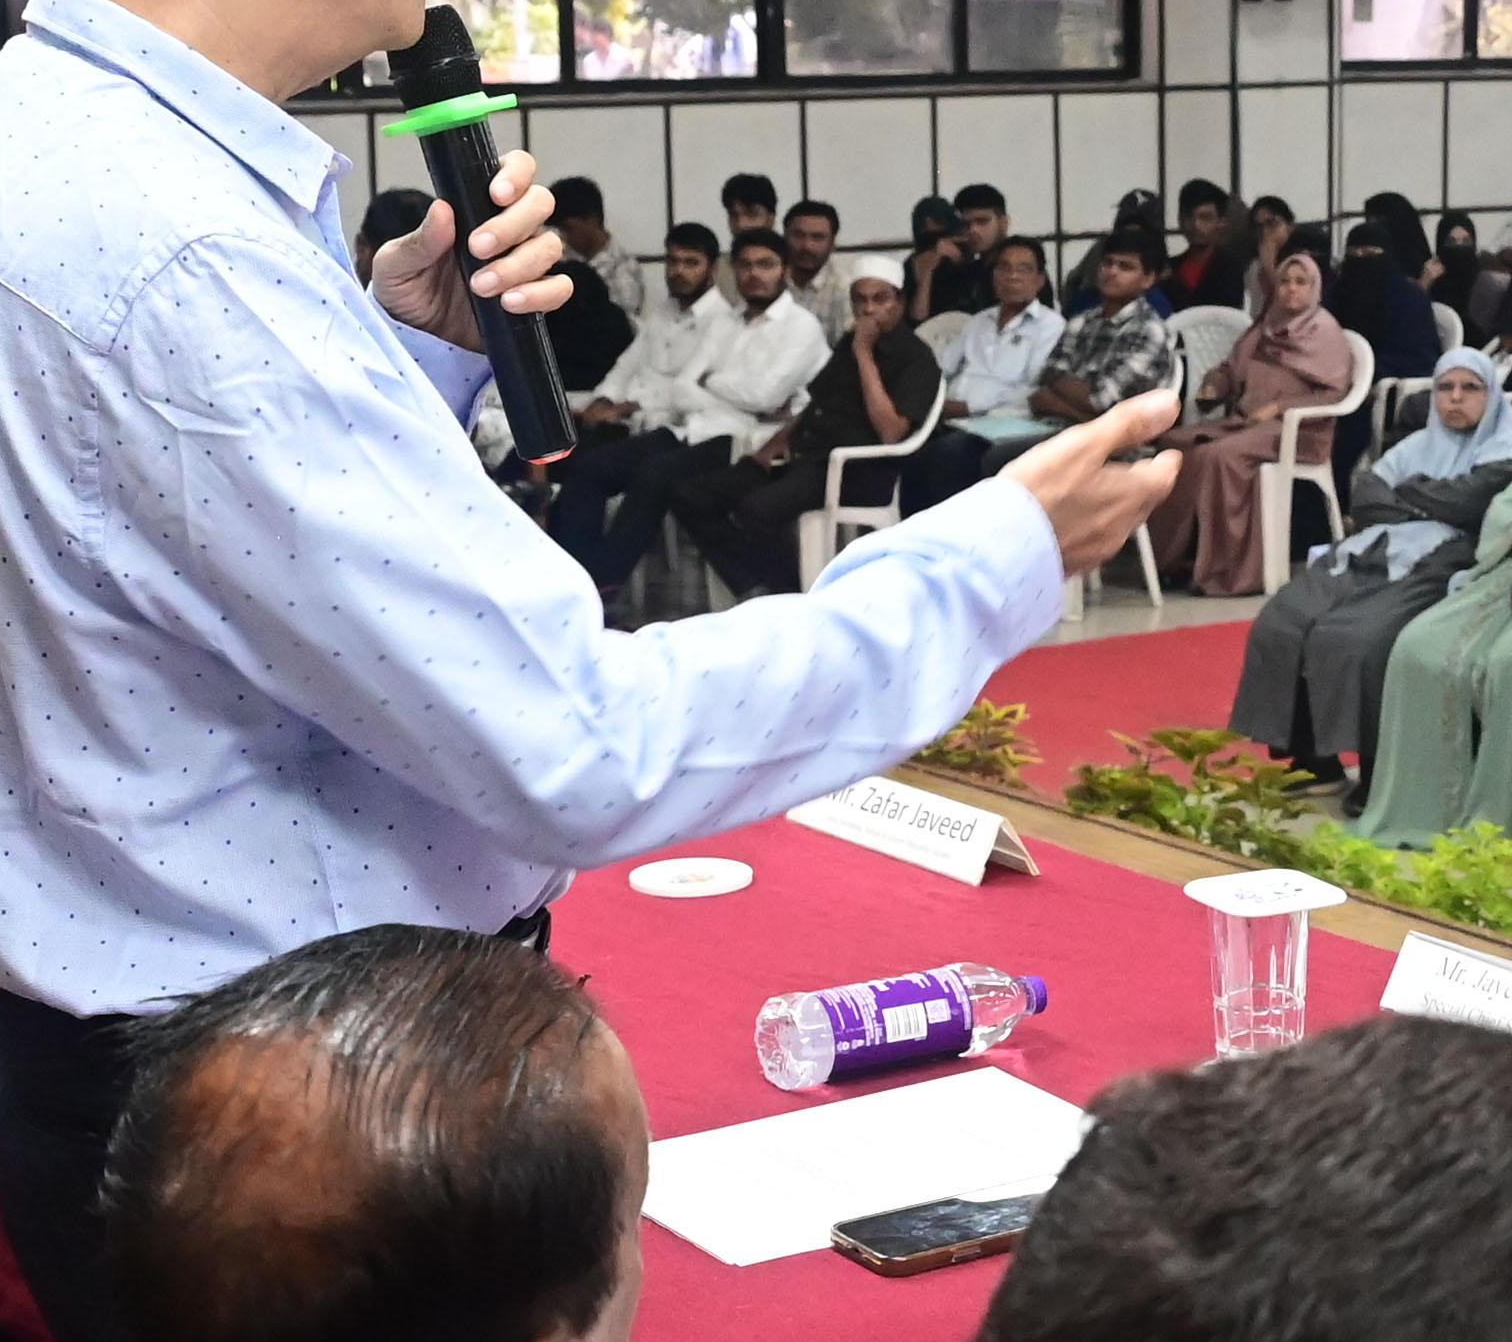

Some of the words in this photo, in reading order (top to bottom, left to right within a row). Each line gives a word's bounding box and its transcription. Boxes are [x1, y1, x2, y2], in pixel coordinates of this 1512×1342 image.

[860, 786, 909, 822] Zafar
[908, 802, 978, 843] Javeed
[1434, 955, 1467, 986] Mr.
